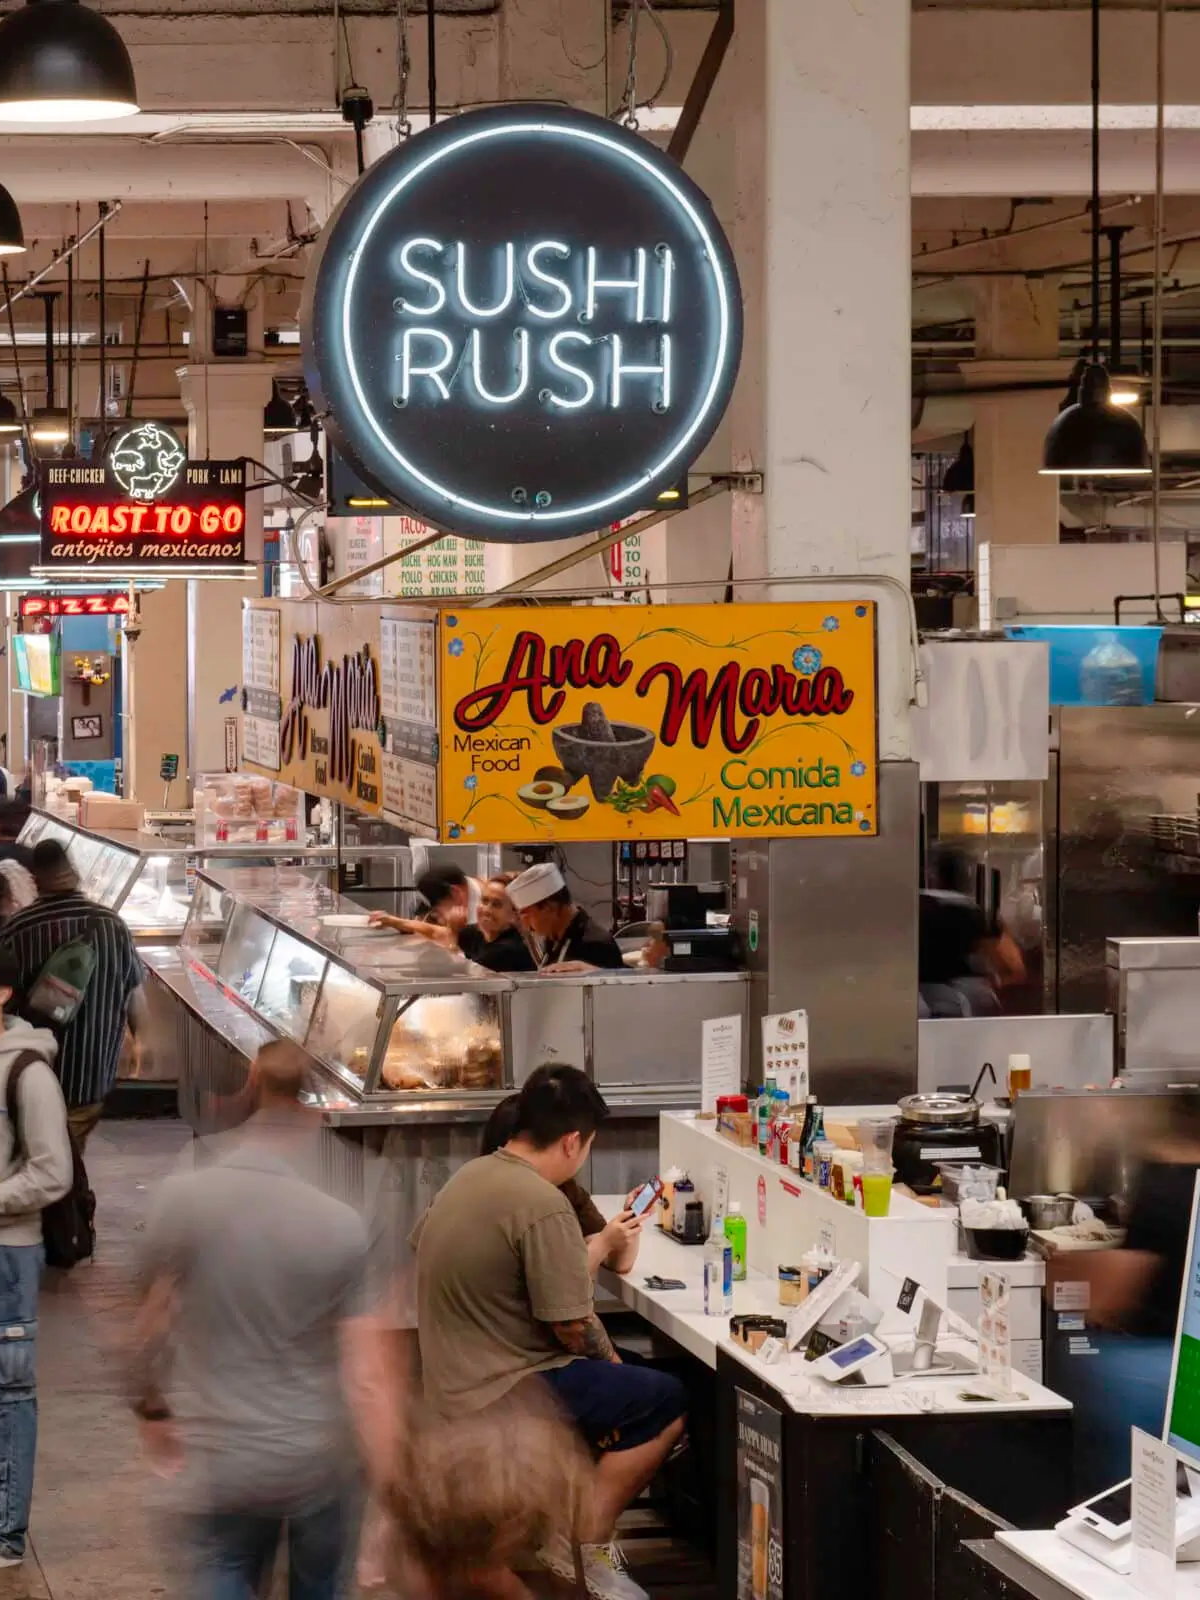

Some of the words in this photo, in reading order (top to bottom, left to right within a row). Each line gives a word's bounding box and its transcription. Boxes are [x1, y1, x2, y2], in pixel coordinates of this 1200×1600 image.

[399, 237, 673, 324] SUSHI
[401, 327, 672, 410] RUSH
[50, 505, 148, 534] ROAST
[155, 505, 192, 534] TO
[199, 505, 244, 534] GO
[51, 538, 134, 564] antojitos
[138, 539, 243, 557] mexicanos
[400, 571, 423, 583] POLLO
[428, 570, 458, 583] CHICKEN
[22, 596, 131, 615] PIZZA
[453, 629, 634, 734] Ana
[635, 660, 855, 755] Maria
[453, 732, 532, 754] Mexican
[470, 754, 521, 773] Food
[720, 757, 841, 791] Comida
[712, 795, 854, 829] Mexicana
